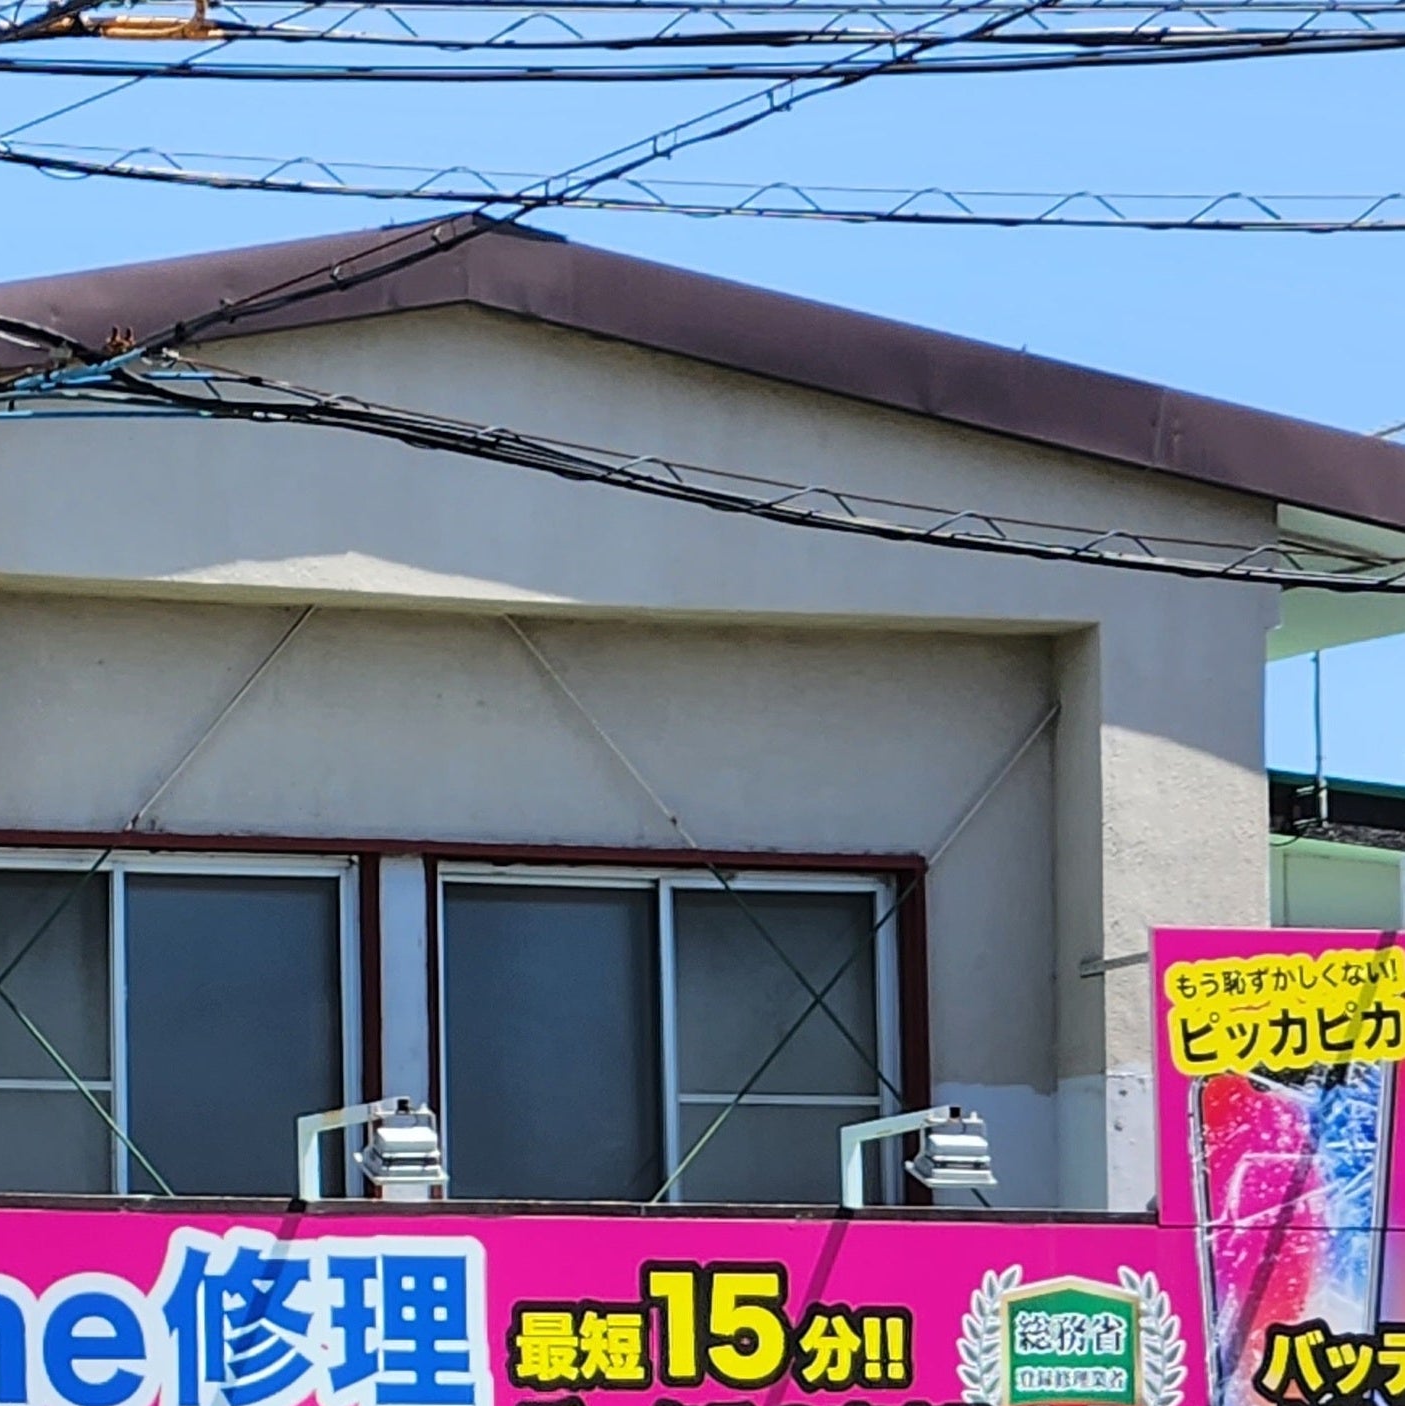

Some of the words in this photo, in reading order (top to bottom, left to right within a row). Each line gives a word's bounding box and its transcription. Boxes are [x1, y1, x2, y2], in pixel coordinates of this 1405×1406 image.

[1177, 959, 1398, 999] もう恥ずかしくない!
[1181, 1001, 1401, 1062] ピッカピカ
[1016, 1312, 1126, 1354] 総務省
